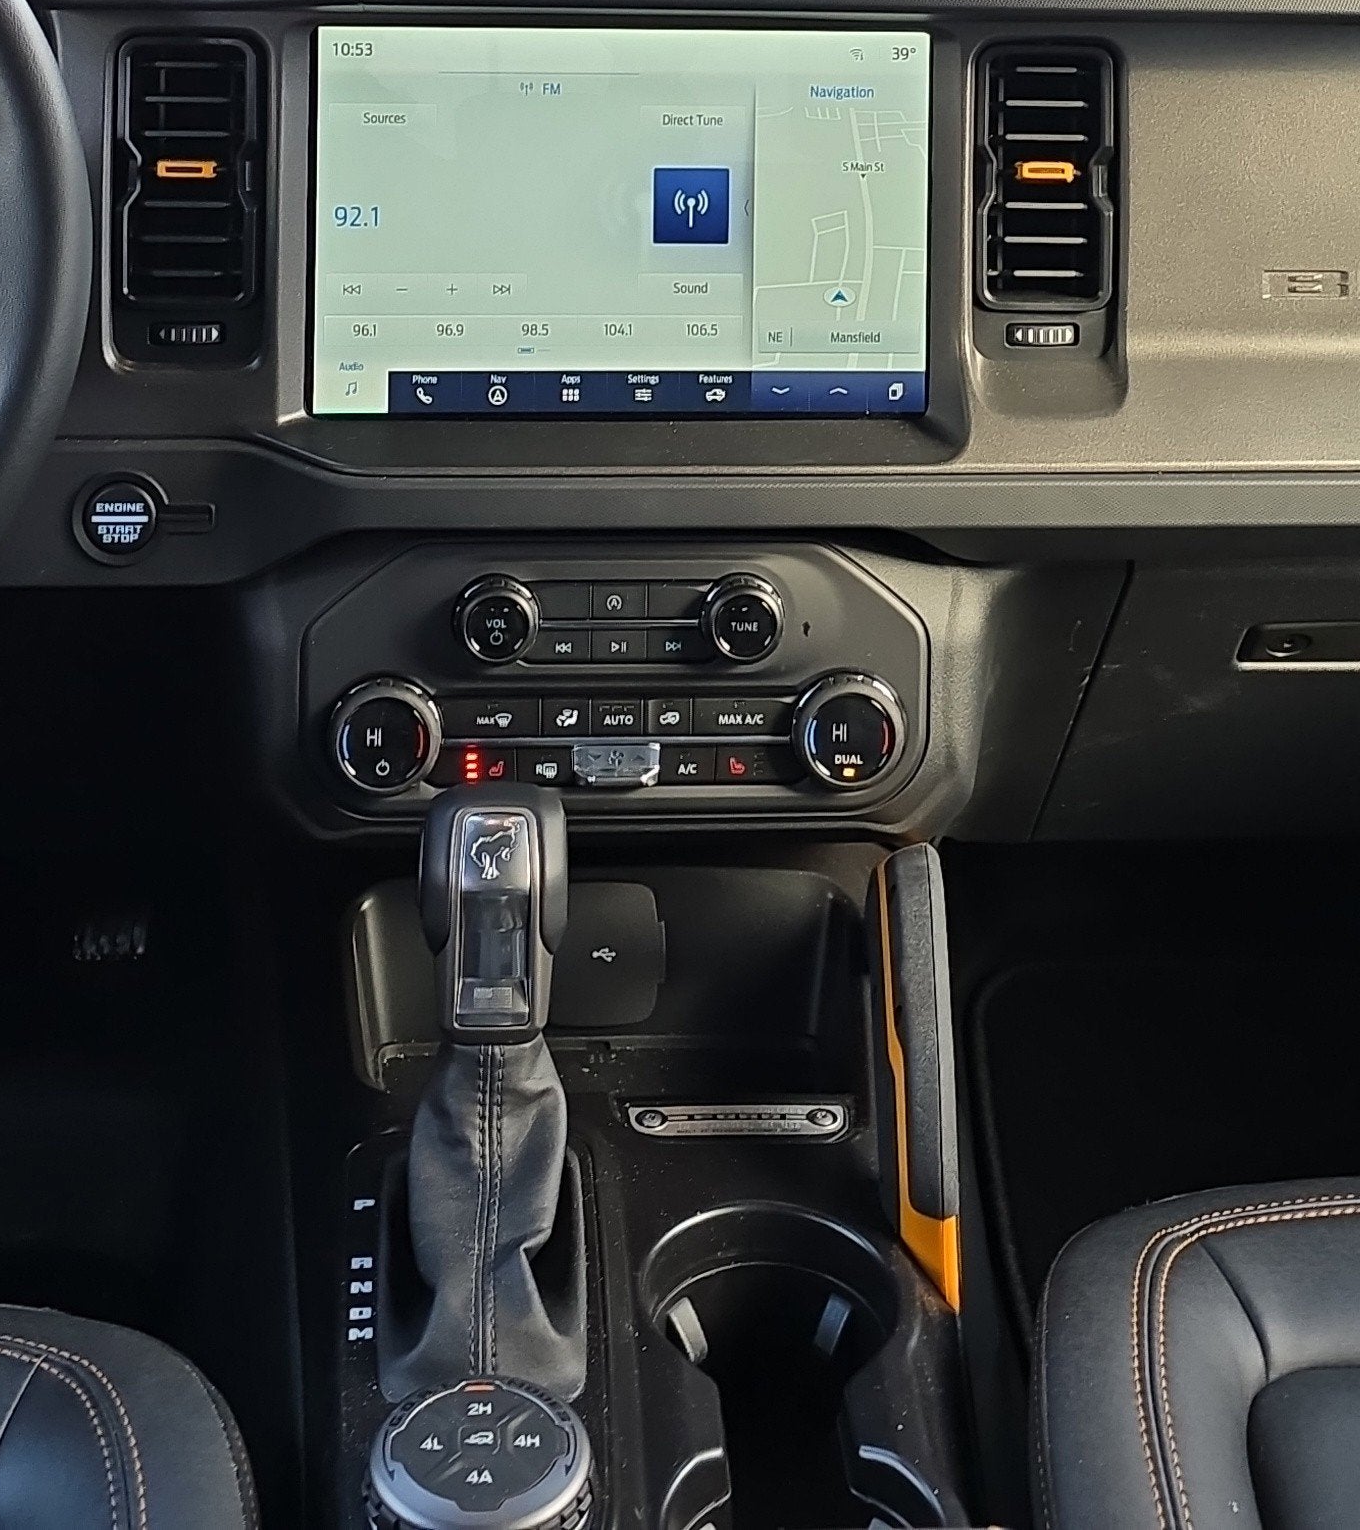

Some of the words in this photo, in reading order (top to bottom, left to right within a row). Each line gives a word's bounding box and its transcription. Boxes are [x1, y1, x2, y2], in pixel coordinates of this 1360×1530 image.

[332, 41, 373, 59] 10:53
[891, 45, 917, 62] 39°
[542, 82, 561, 96] FM
[809, 85, 874, 102] Navigation
[362, 111, 406, 125] Sources
[661, 113, 694, 126] Direct
[696, 113, 723, 126] Tune
[842, 162, 848, 172] S
[848, 162, 871, 172] Main
[872, 162, 884, 172] St
[333, 205, 380, 228] 92.1
[673, 281, 708, 295] Sound
[352, 323, 378, 337] 96.1
[436, 323, 465, 337] 96.9
[521, 323, 550, 337] 98.5
[603, 323, 633, 337] 104.1
[685, 323, 719, 337] 106.5
[767, 331, 783, 344] NE
[830, 330, 881, 344] Mansfield
[339, 361, 364, 371] Audio
[411, 374, 438, 384] Phone
[490, 374, 507, 384] Nav
[561, 374, 581, 386] Apps
[627, 374, 659, 386] Settings
[698, 374, 733, 384] Features
[95, 502, 145, 513] ENGINE
[97, 524, 143, 535] START
[102, 533, 139, 544] STOP
[485, 619, 507, 629] VOL
[730, 621, 759, 632] TUNE
[476, 716, 495, 725] MAX
[604, 715, 634, 726] AUTO
[718, 715, 742, 726] MAX
[744, 715, 764, 726] A/C
[366, 727, 382, 748] HI
[832, 723, 848, 743] HI
[834, 754, 864, 765] DUAL
[535, 763, 542, 775] R
[678, 763, 697, 775] A/C
[353, 1199, 375, 1210] P
[350, 1281, 373, 1294] N
[348, 1327, 374, 1341] M
[467, 1402, 493, 1416] 2H
[419, 1435, 444, 1451] 4L
[513, 1433, 540, 1448] 4H
[466, 1469, 493, 1484] 4A
